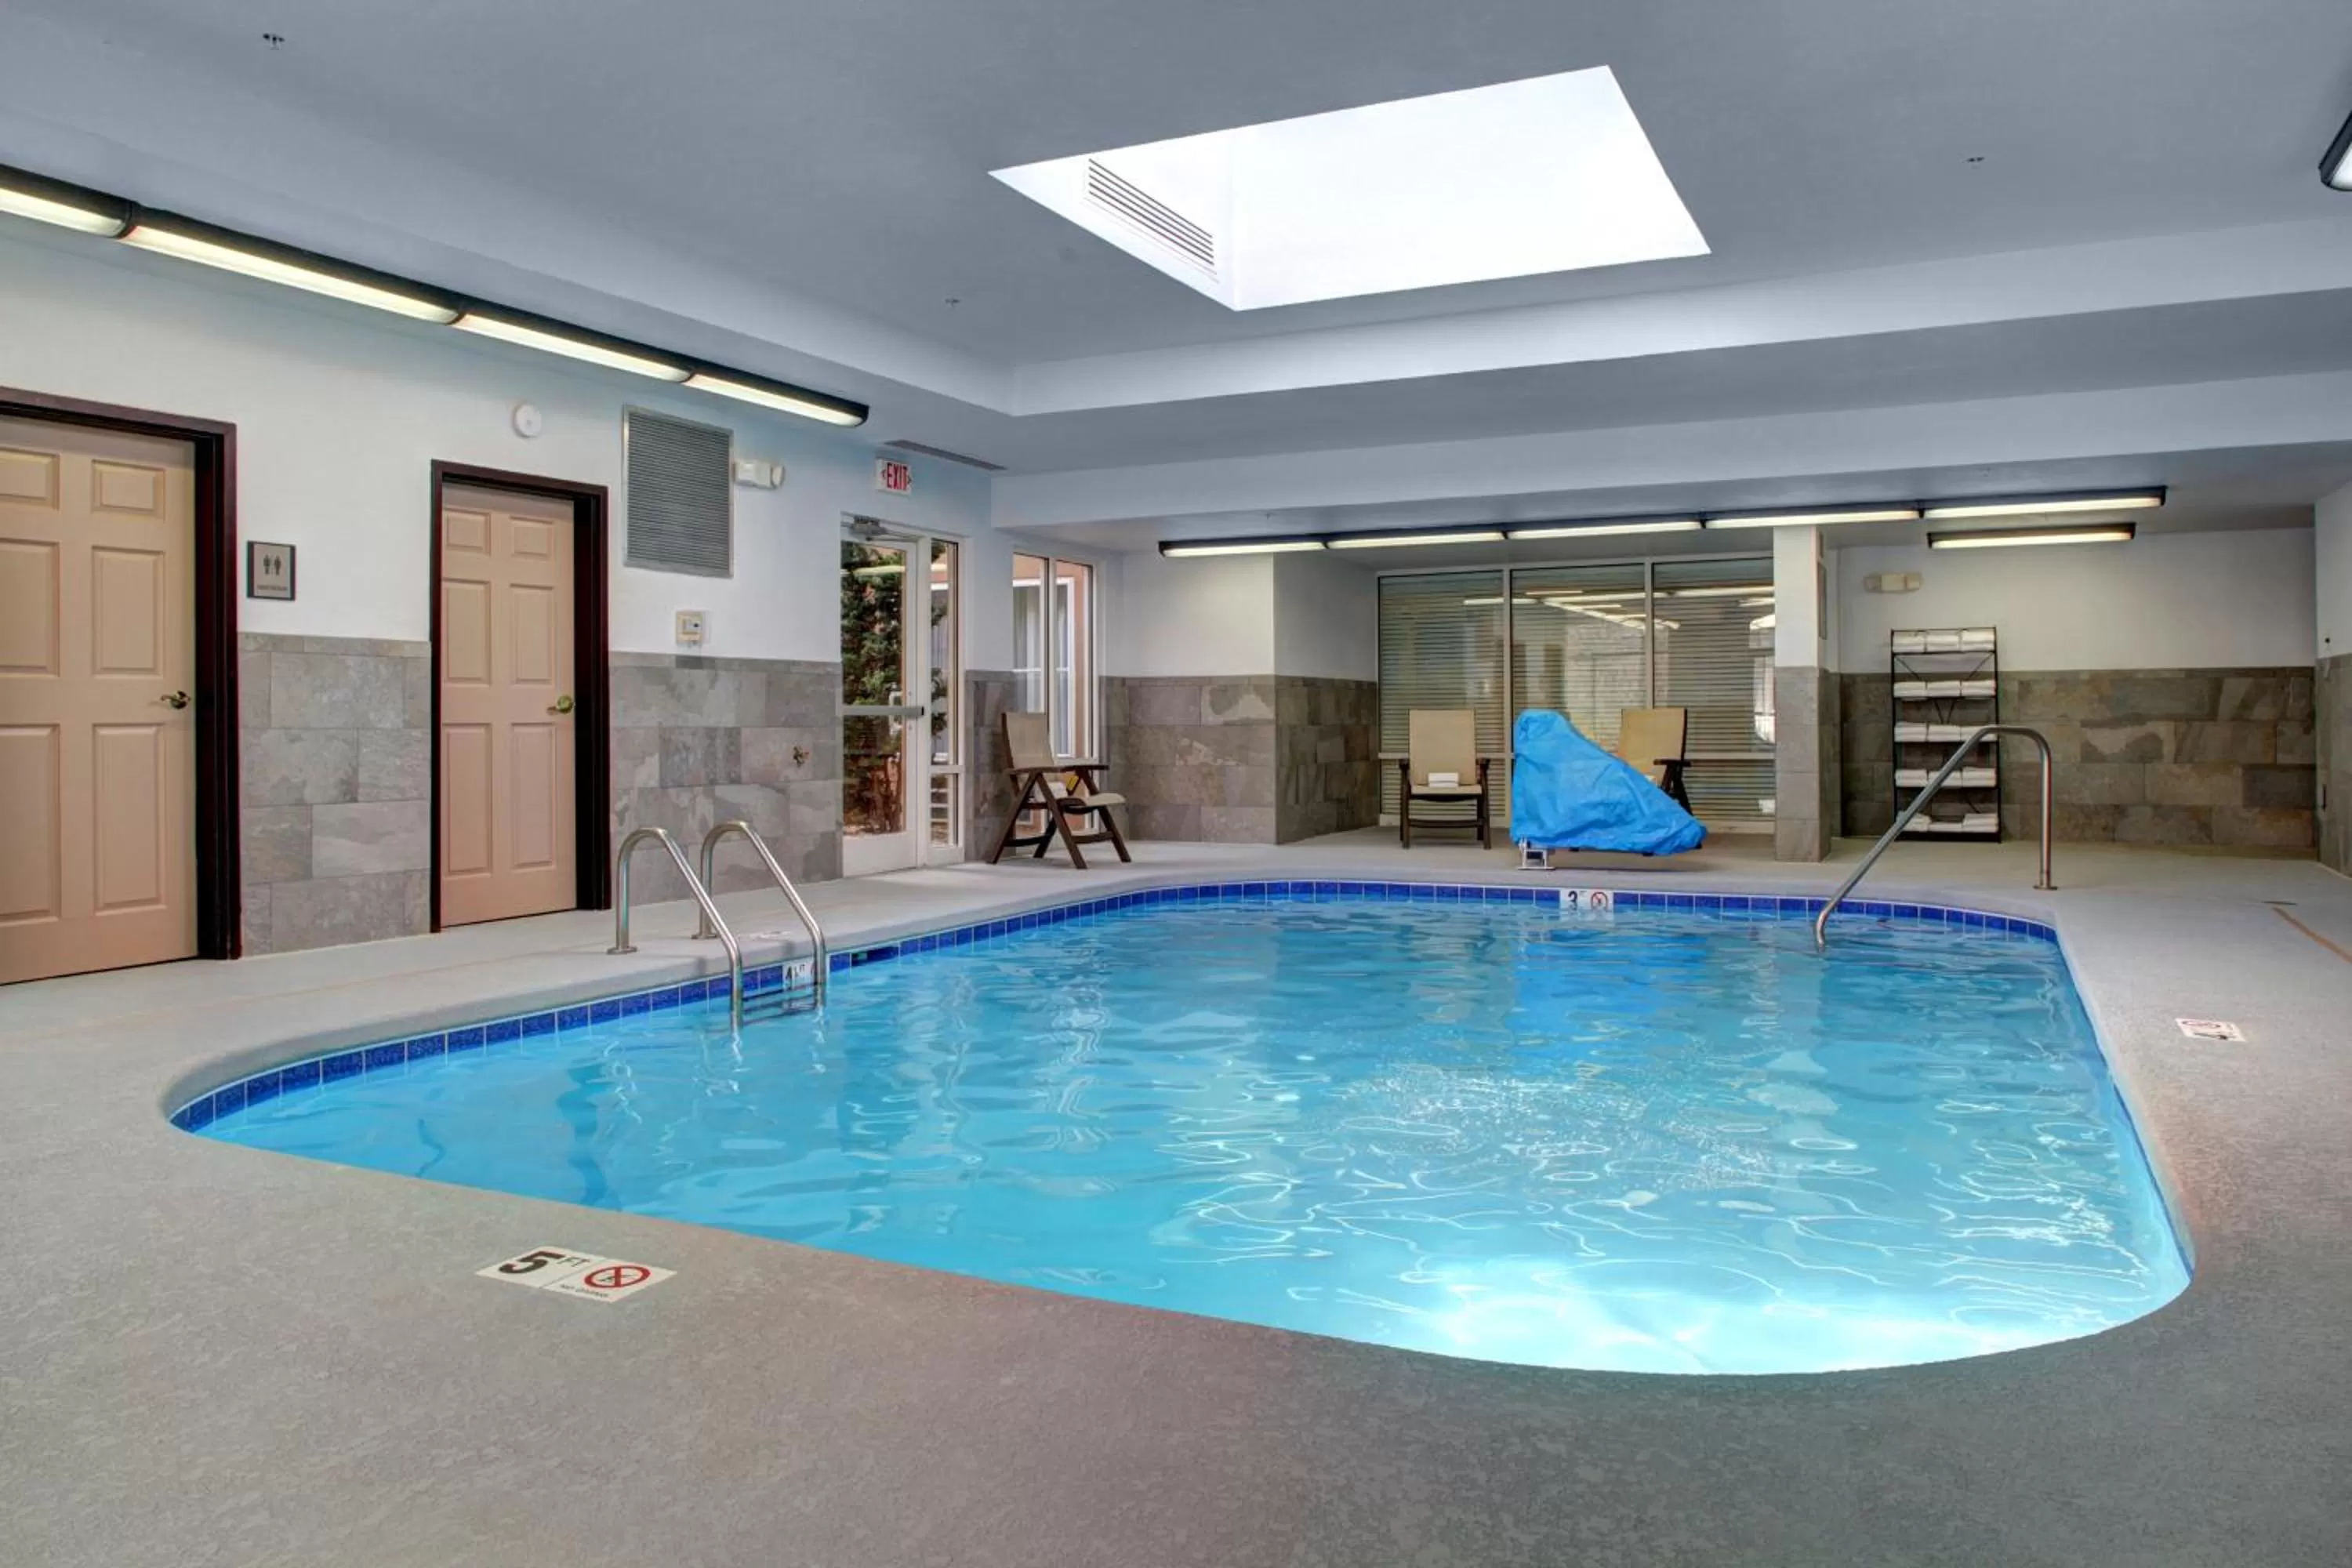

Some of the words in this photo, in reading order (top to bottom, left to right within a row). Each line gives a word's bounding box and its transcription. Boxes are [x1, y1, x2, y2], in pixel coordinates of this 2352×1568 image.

[887, 462, 907, 491] EXIT
[499, 1250, 566, 1273] 5
[557, 1257, 590, 1267] FT
